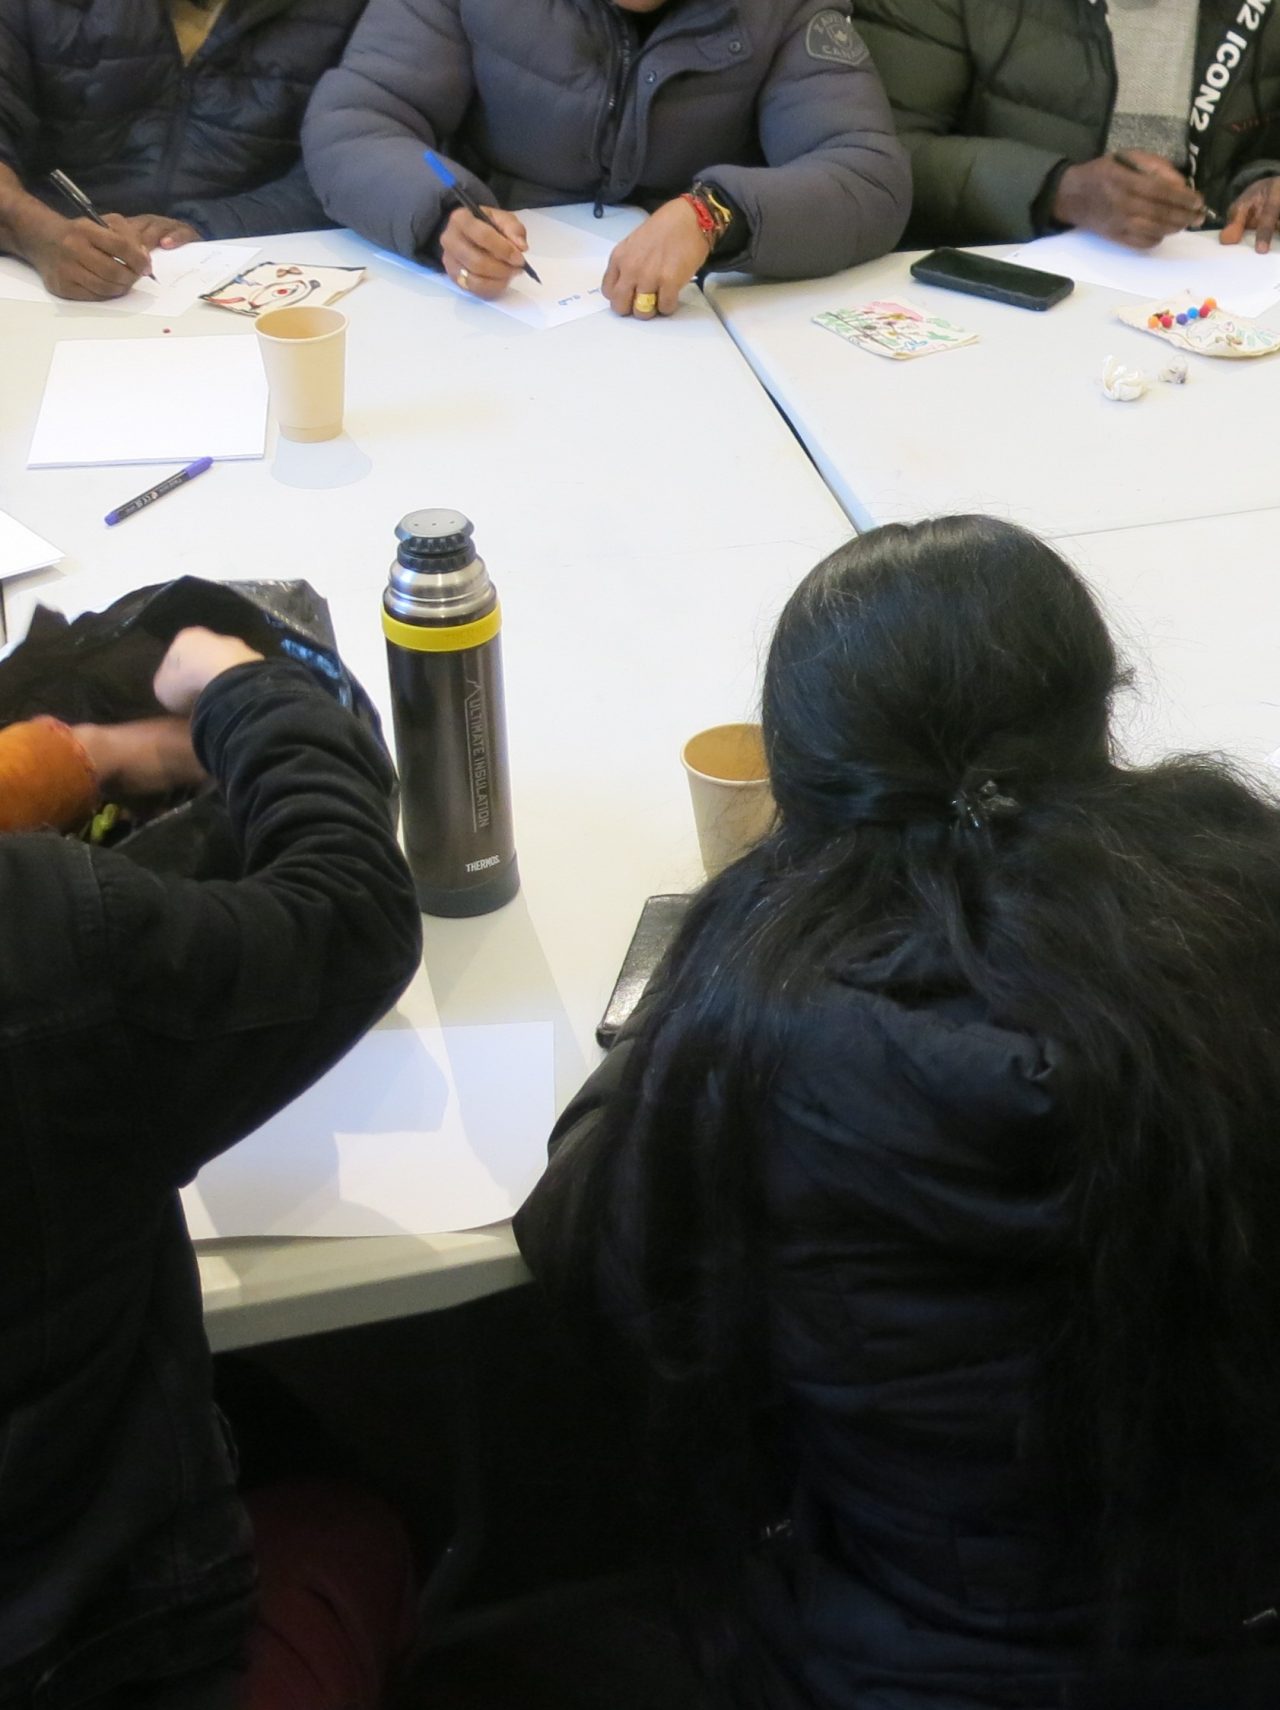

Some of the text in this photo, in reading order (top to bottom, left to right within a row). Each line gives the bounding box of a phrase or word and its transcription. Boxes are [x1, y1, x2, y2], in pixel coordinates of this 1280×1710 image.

[1190, 31, 1247, 131] ICON2
[468, 699, 491, 829] ULTIMATE INSULATION
